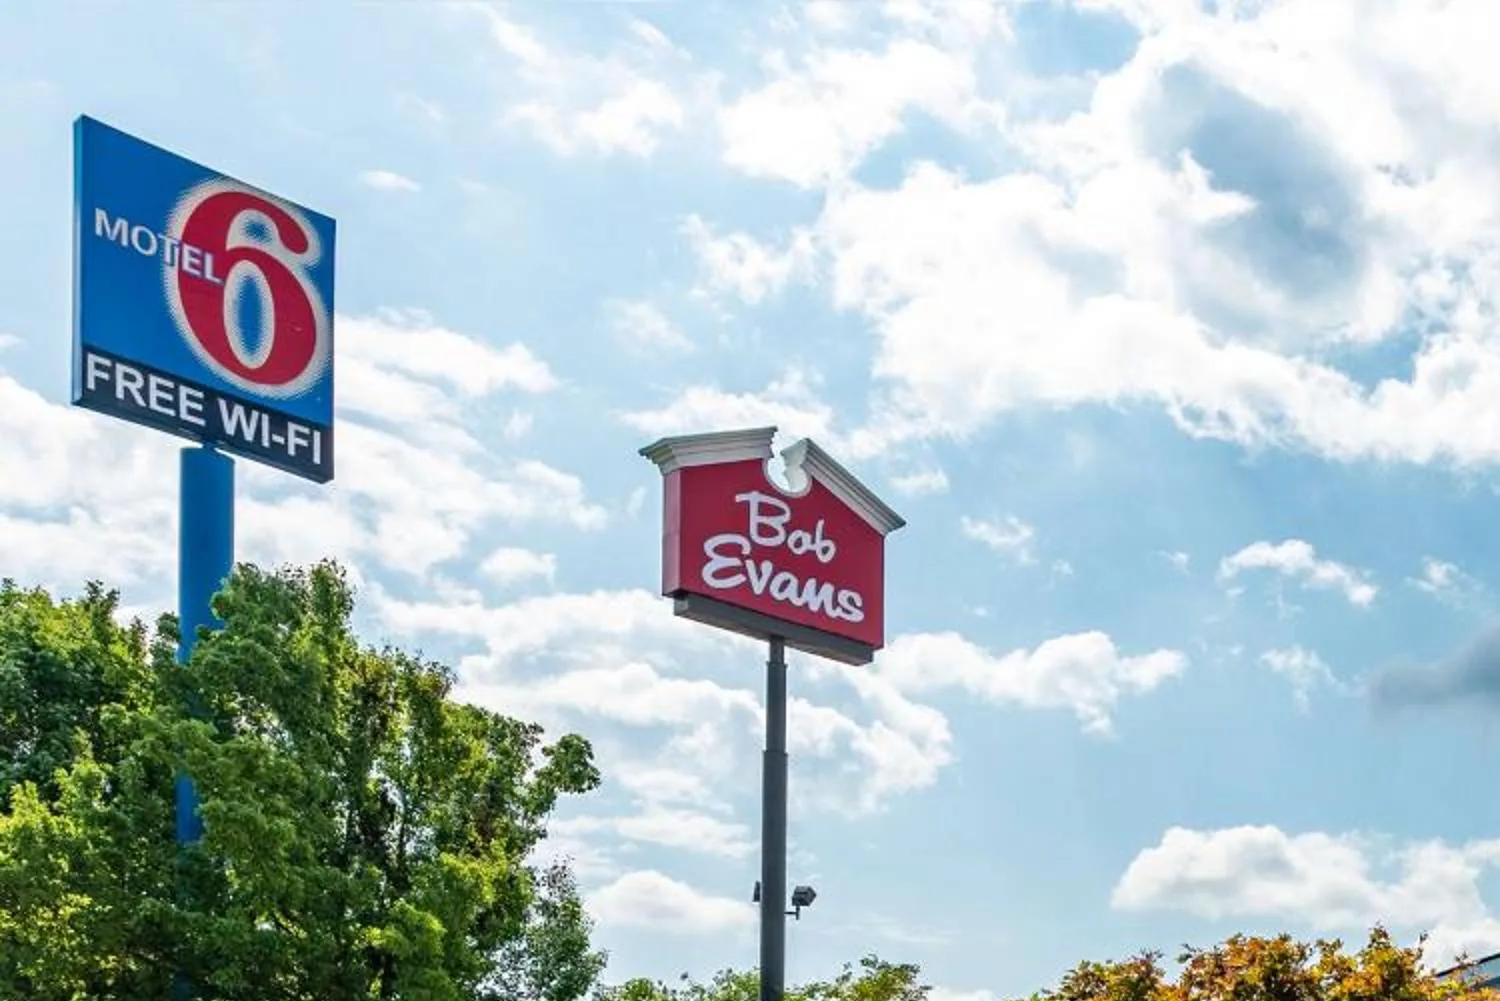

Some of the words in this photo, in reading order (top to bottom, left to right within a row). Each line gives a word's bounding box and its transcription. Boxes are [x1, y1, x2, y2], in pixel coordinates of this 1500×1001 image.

[94, 206, 225, 285] MOTEL
[174, 184, 322, 393] 6
[86, 353, 206, 426] FREE
[218, 397, 322, 465] WI-FI
[735, 490, 836, 563] Bob
[702, 533, 865, 623] Evans
